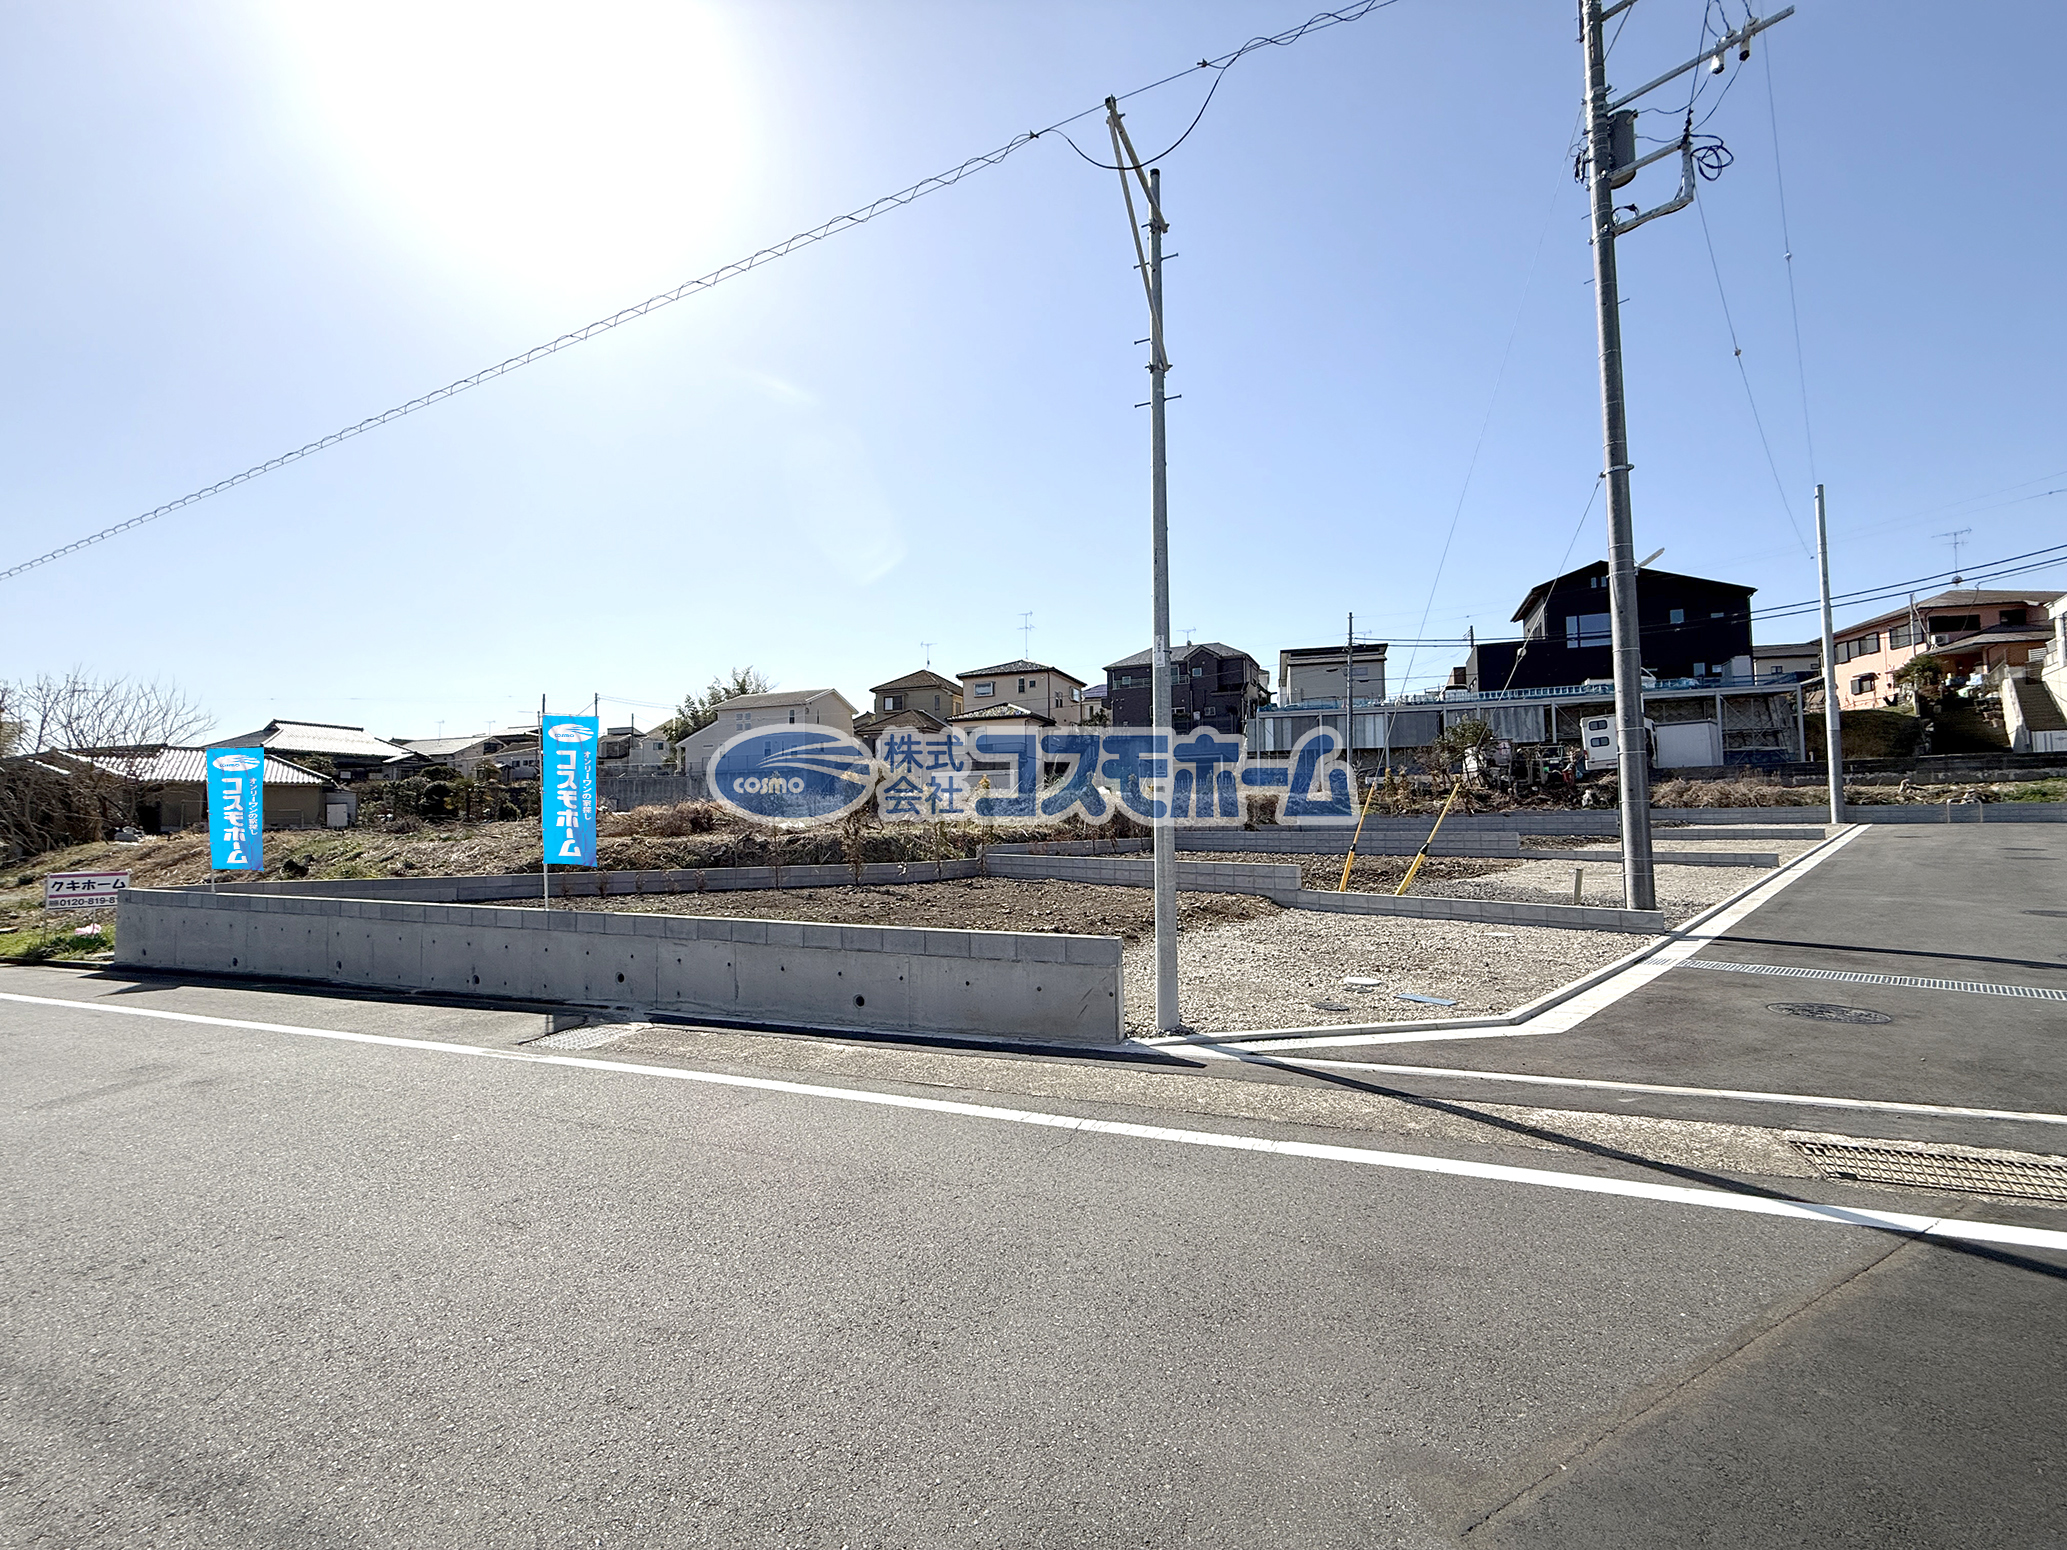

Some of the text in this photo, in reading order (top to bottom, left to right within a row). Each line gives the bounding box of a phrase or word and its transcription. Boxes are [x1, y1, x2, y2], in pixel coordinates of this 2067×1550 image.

[221, 777, 248, 864] コスモホーム
[556, 750, 582, 857] コスモホーム
[51, 878, 126, 892] クキホーム
[60, 896, 118, 907] 0120-819-8
